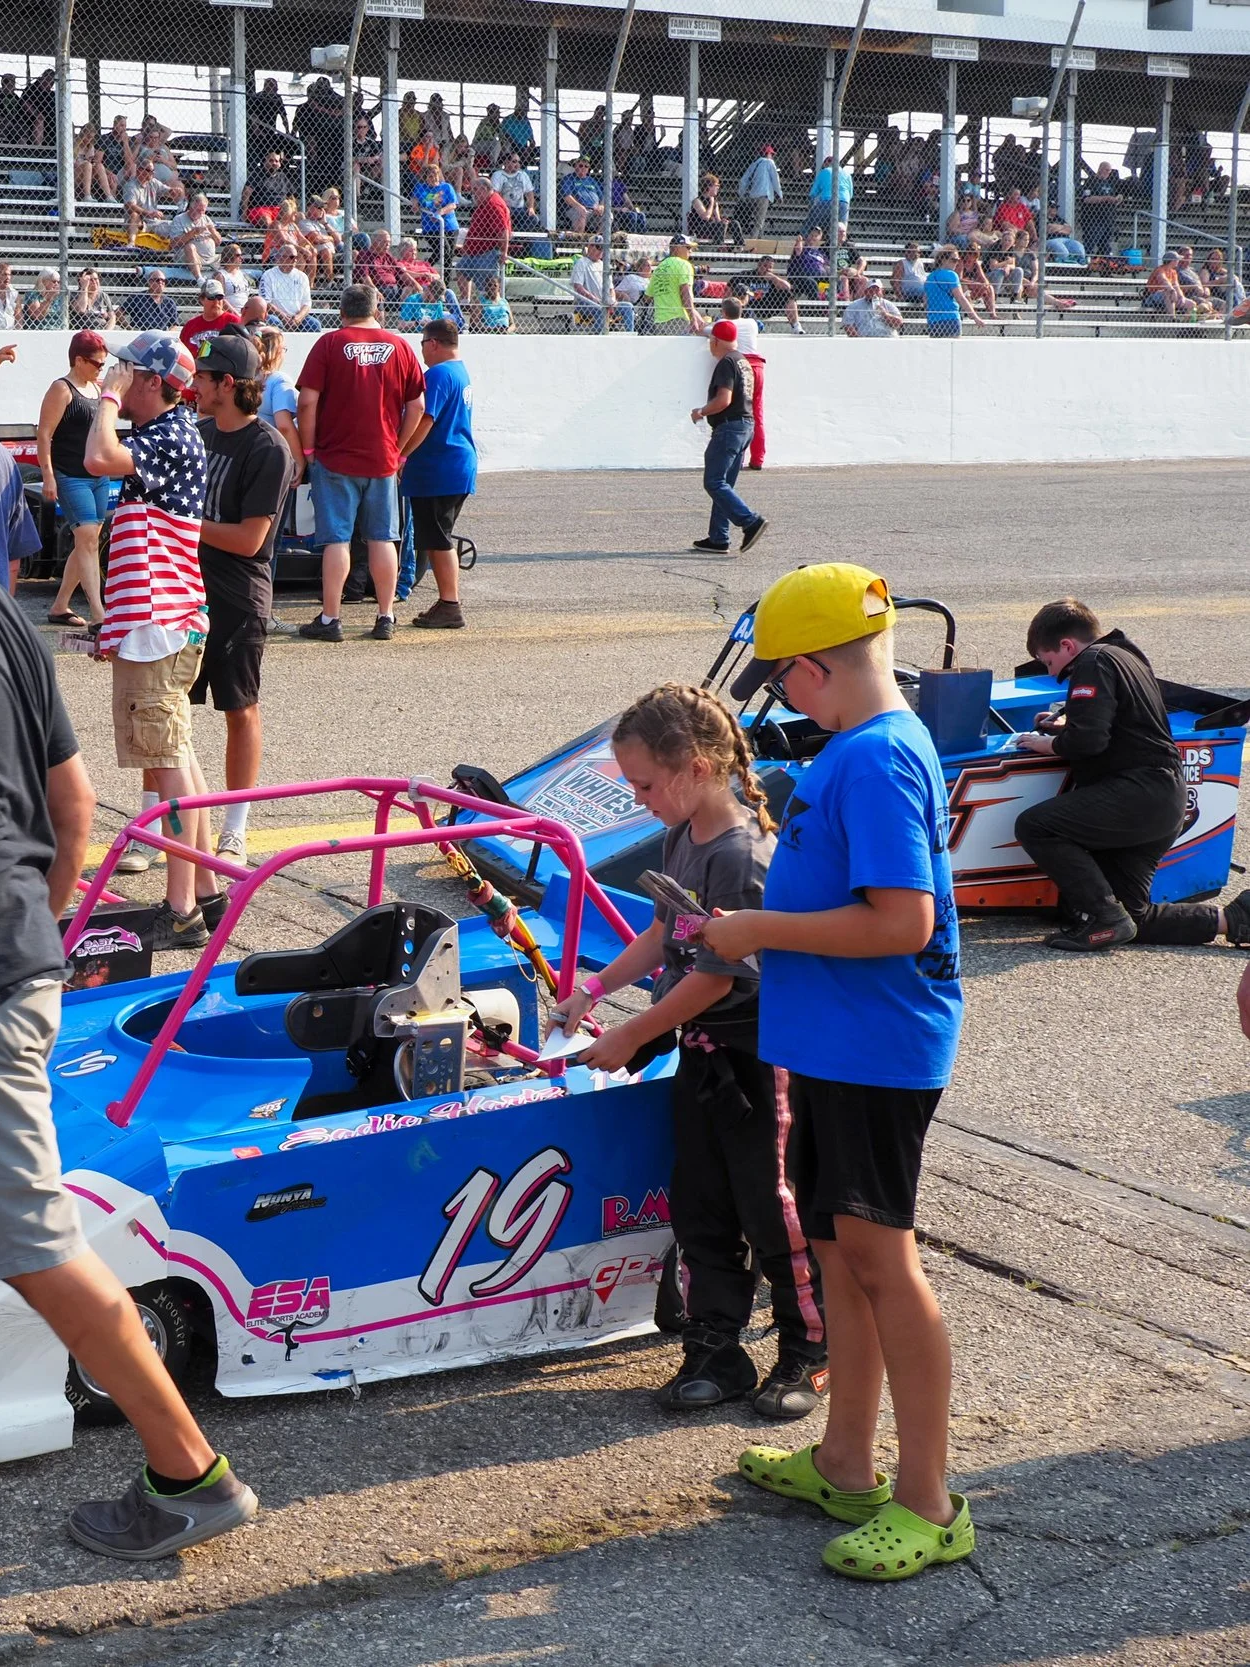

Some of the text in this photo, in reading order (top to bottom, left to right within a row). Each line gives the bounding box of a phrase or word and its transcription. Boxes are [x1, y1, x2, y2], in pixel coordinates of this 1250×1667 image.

[670, 19, 720, 31] FAMILY SECTION
[1182, 748, 1212, 766] DS
[550, 787, 582, 807] HEATING
[561, 767, 639, 816] WHITES
[556, 805, 576, 820] AND
[578, 803, 614, 825] COOLING
[418, 1145, 574, 1306] 19
[603, 1220, 672, 1236] MANUFACTURING COMPAN
[590, 1254, 652, 1290] GP
[246, 1276, 330, 1320] ESA
[246, 1318, 266, 1328] ELITE
[295, 1309, 329, 1321] ACADEMY
